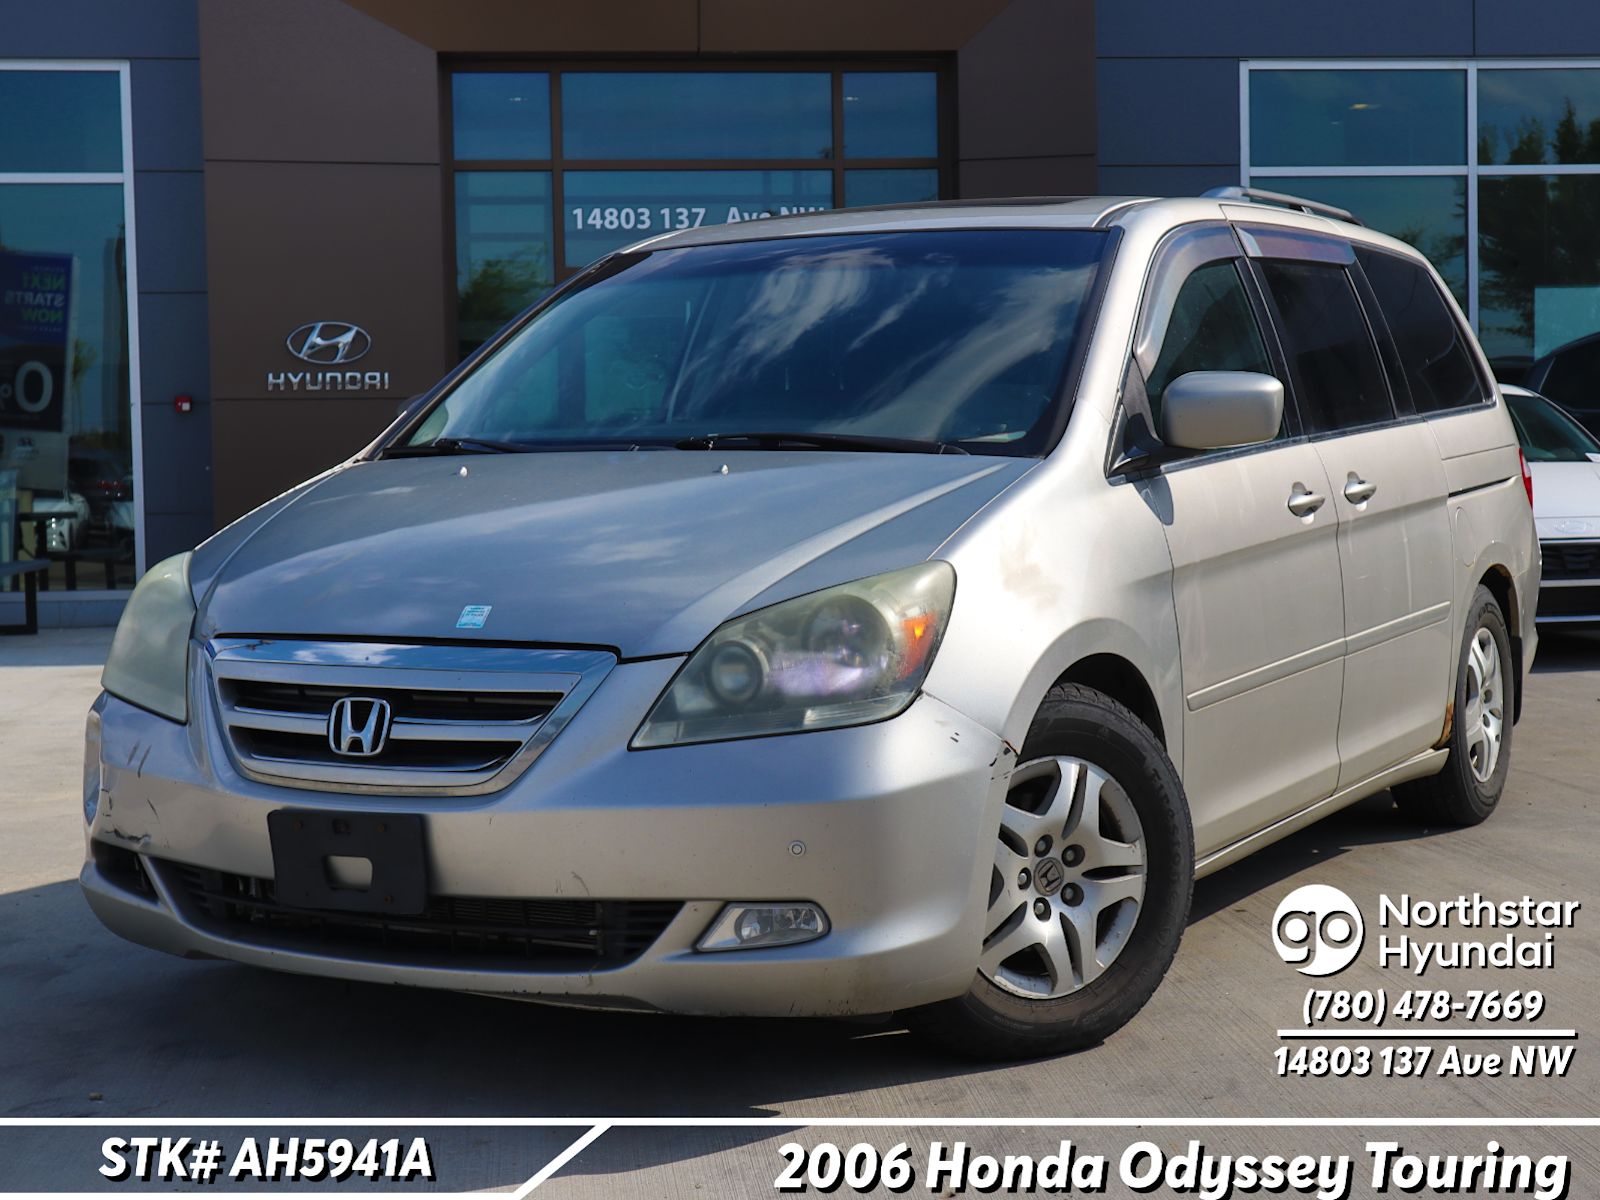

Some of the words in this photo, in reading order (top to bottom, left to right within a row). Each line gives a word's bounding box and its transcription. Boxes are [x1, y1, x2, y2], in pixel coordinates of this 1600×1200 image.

[572, 207, 651, 229] 14803
[660, 207, 706, 229] 137
[267, 371, 389, 391] HYUNDAI
